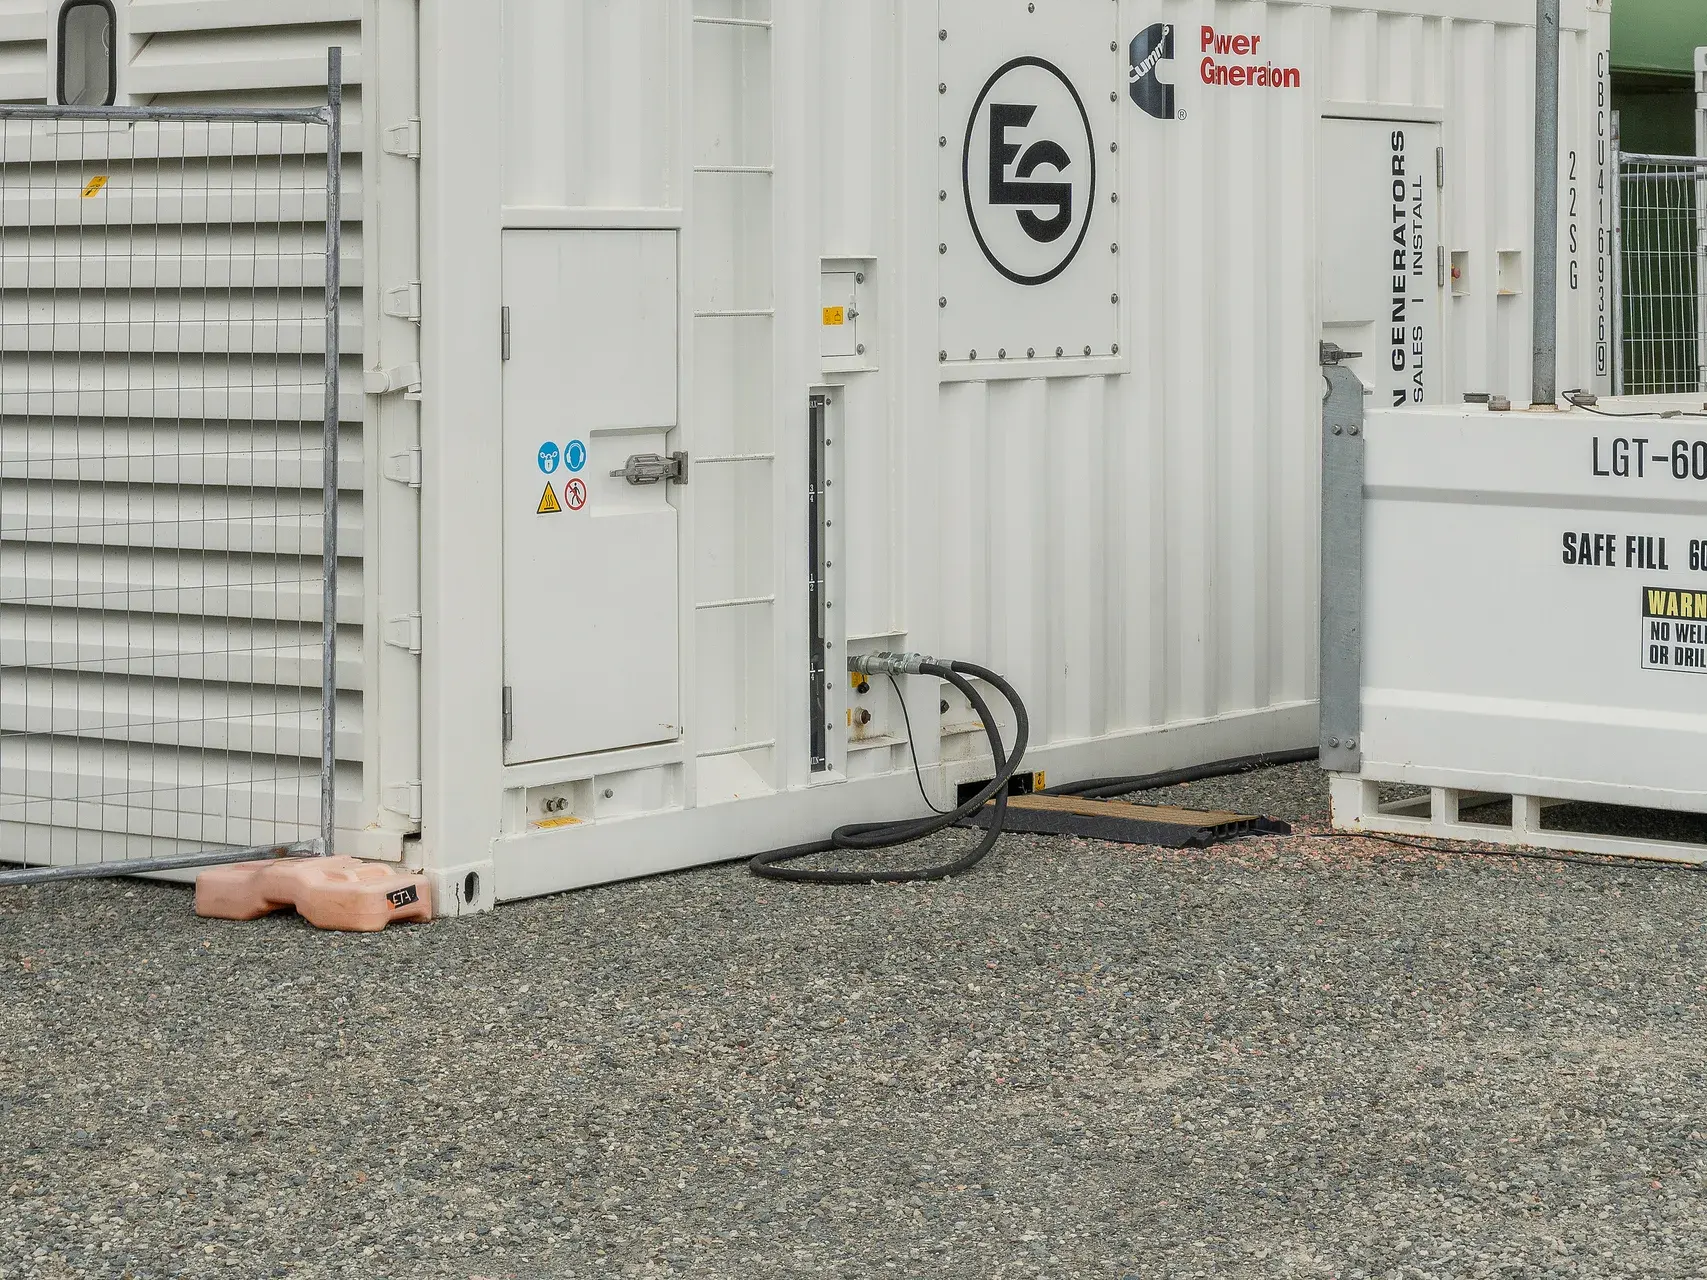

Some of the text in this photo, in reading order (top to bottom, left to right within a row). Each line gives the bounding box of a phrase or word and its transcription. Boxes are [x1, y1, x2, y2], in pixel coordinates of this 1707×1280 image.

[1412, 175, 1423, 276] INSTALL
[1569, 150, 1578, 290] 22SG
[1391, 130, 1406, 372] GENERATORS
[1412, 325, 1424, 402] SALES
[1562, 531, 1616, 567] SAFE
[1625, 535, 1669, 571] FILL
[1647, 590, 1707, 618] WARN
[1650, 621, 1707, 645] NO WEL
[1649, 644, 1669, 665] OR
